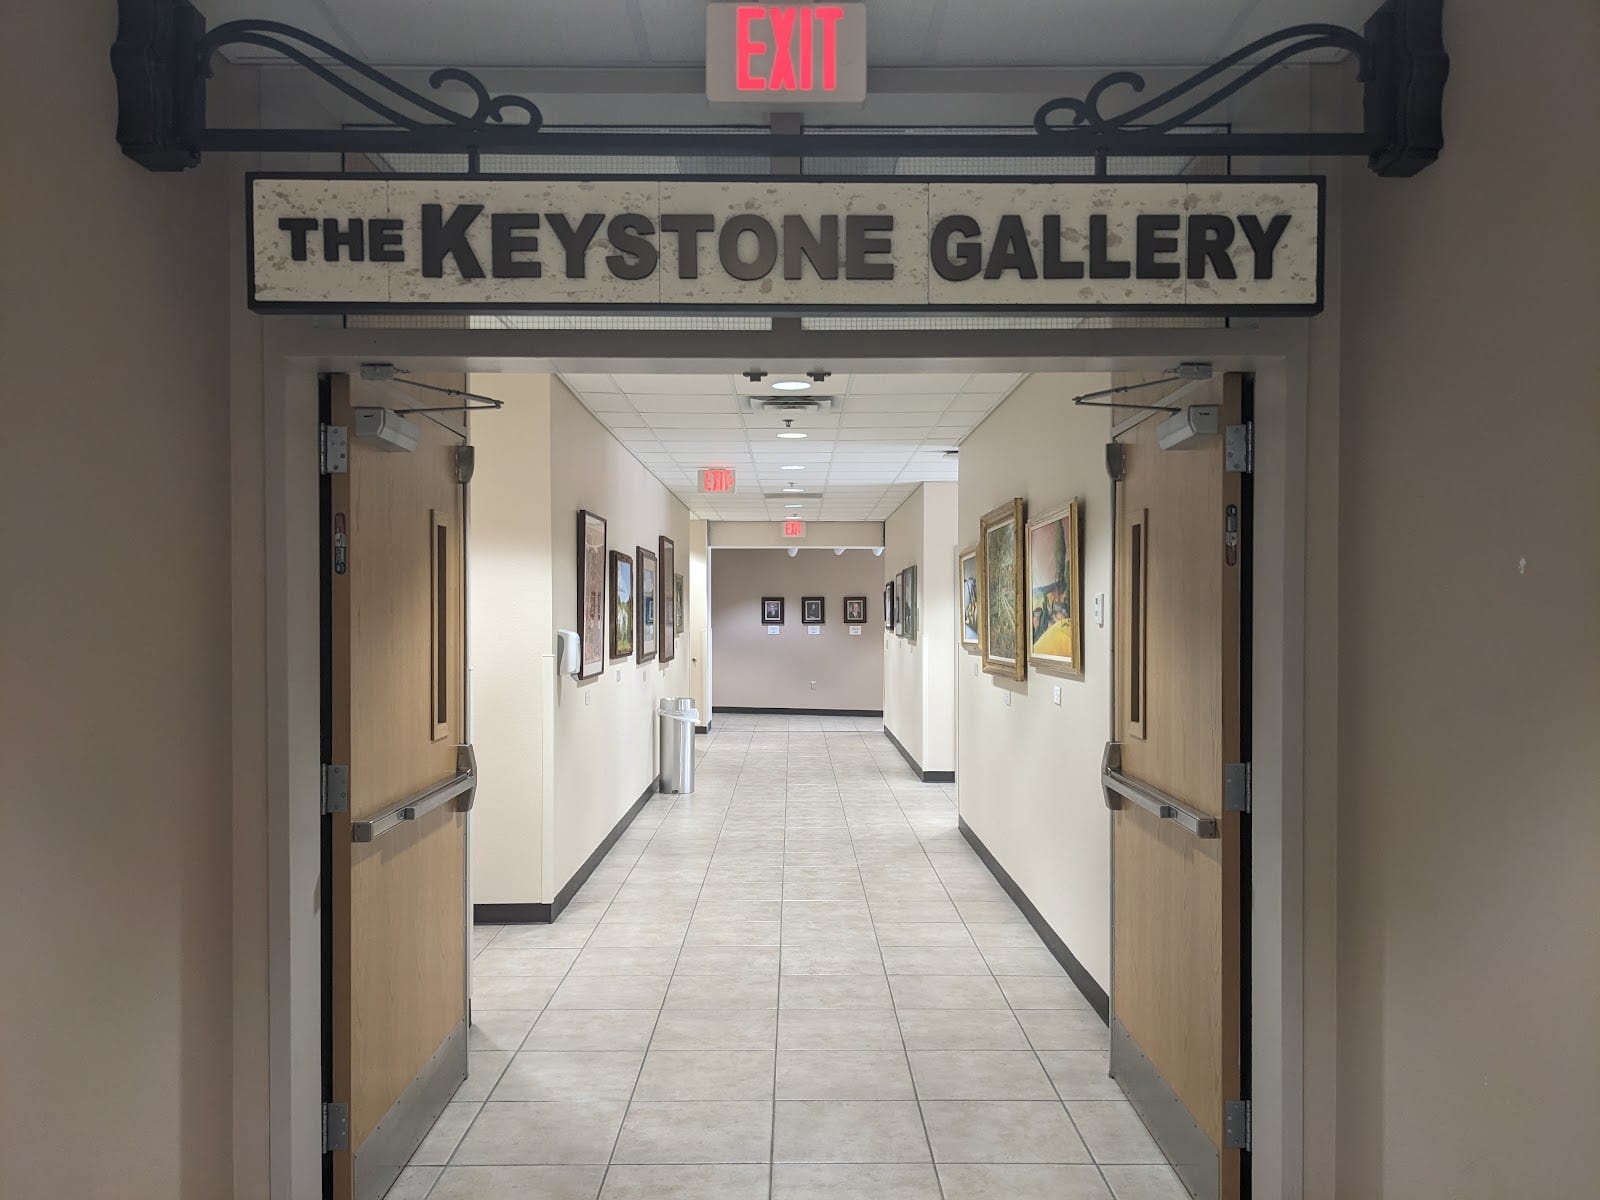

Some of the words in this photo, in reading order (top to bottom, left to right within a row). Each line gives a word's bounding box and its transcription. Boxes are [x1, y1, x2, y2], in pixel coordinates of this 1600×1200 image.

[736, 6, 844, 91] EXIT
[278, 217, 405, 262] THE
[421, 203, 894, 281] KEYSTONE
[930, 214, 1292, 281] GALLERY
[703, 470, 732, 491] EXIT
